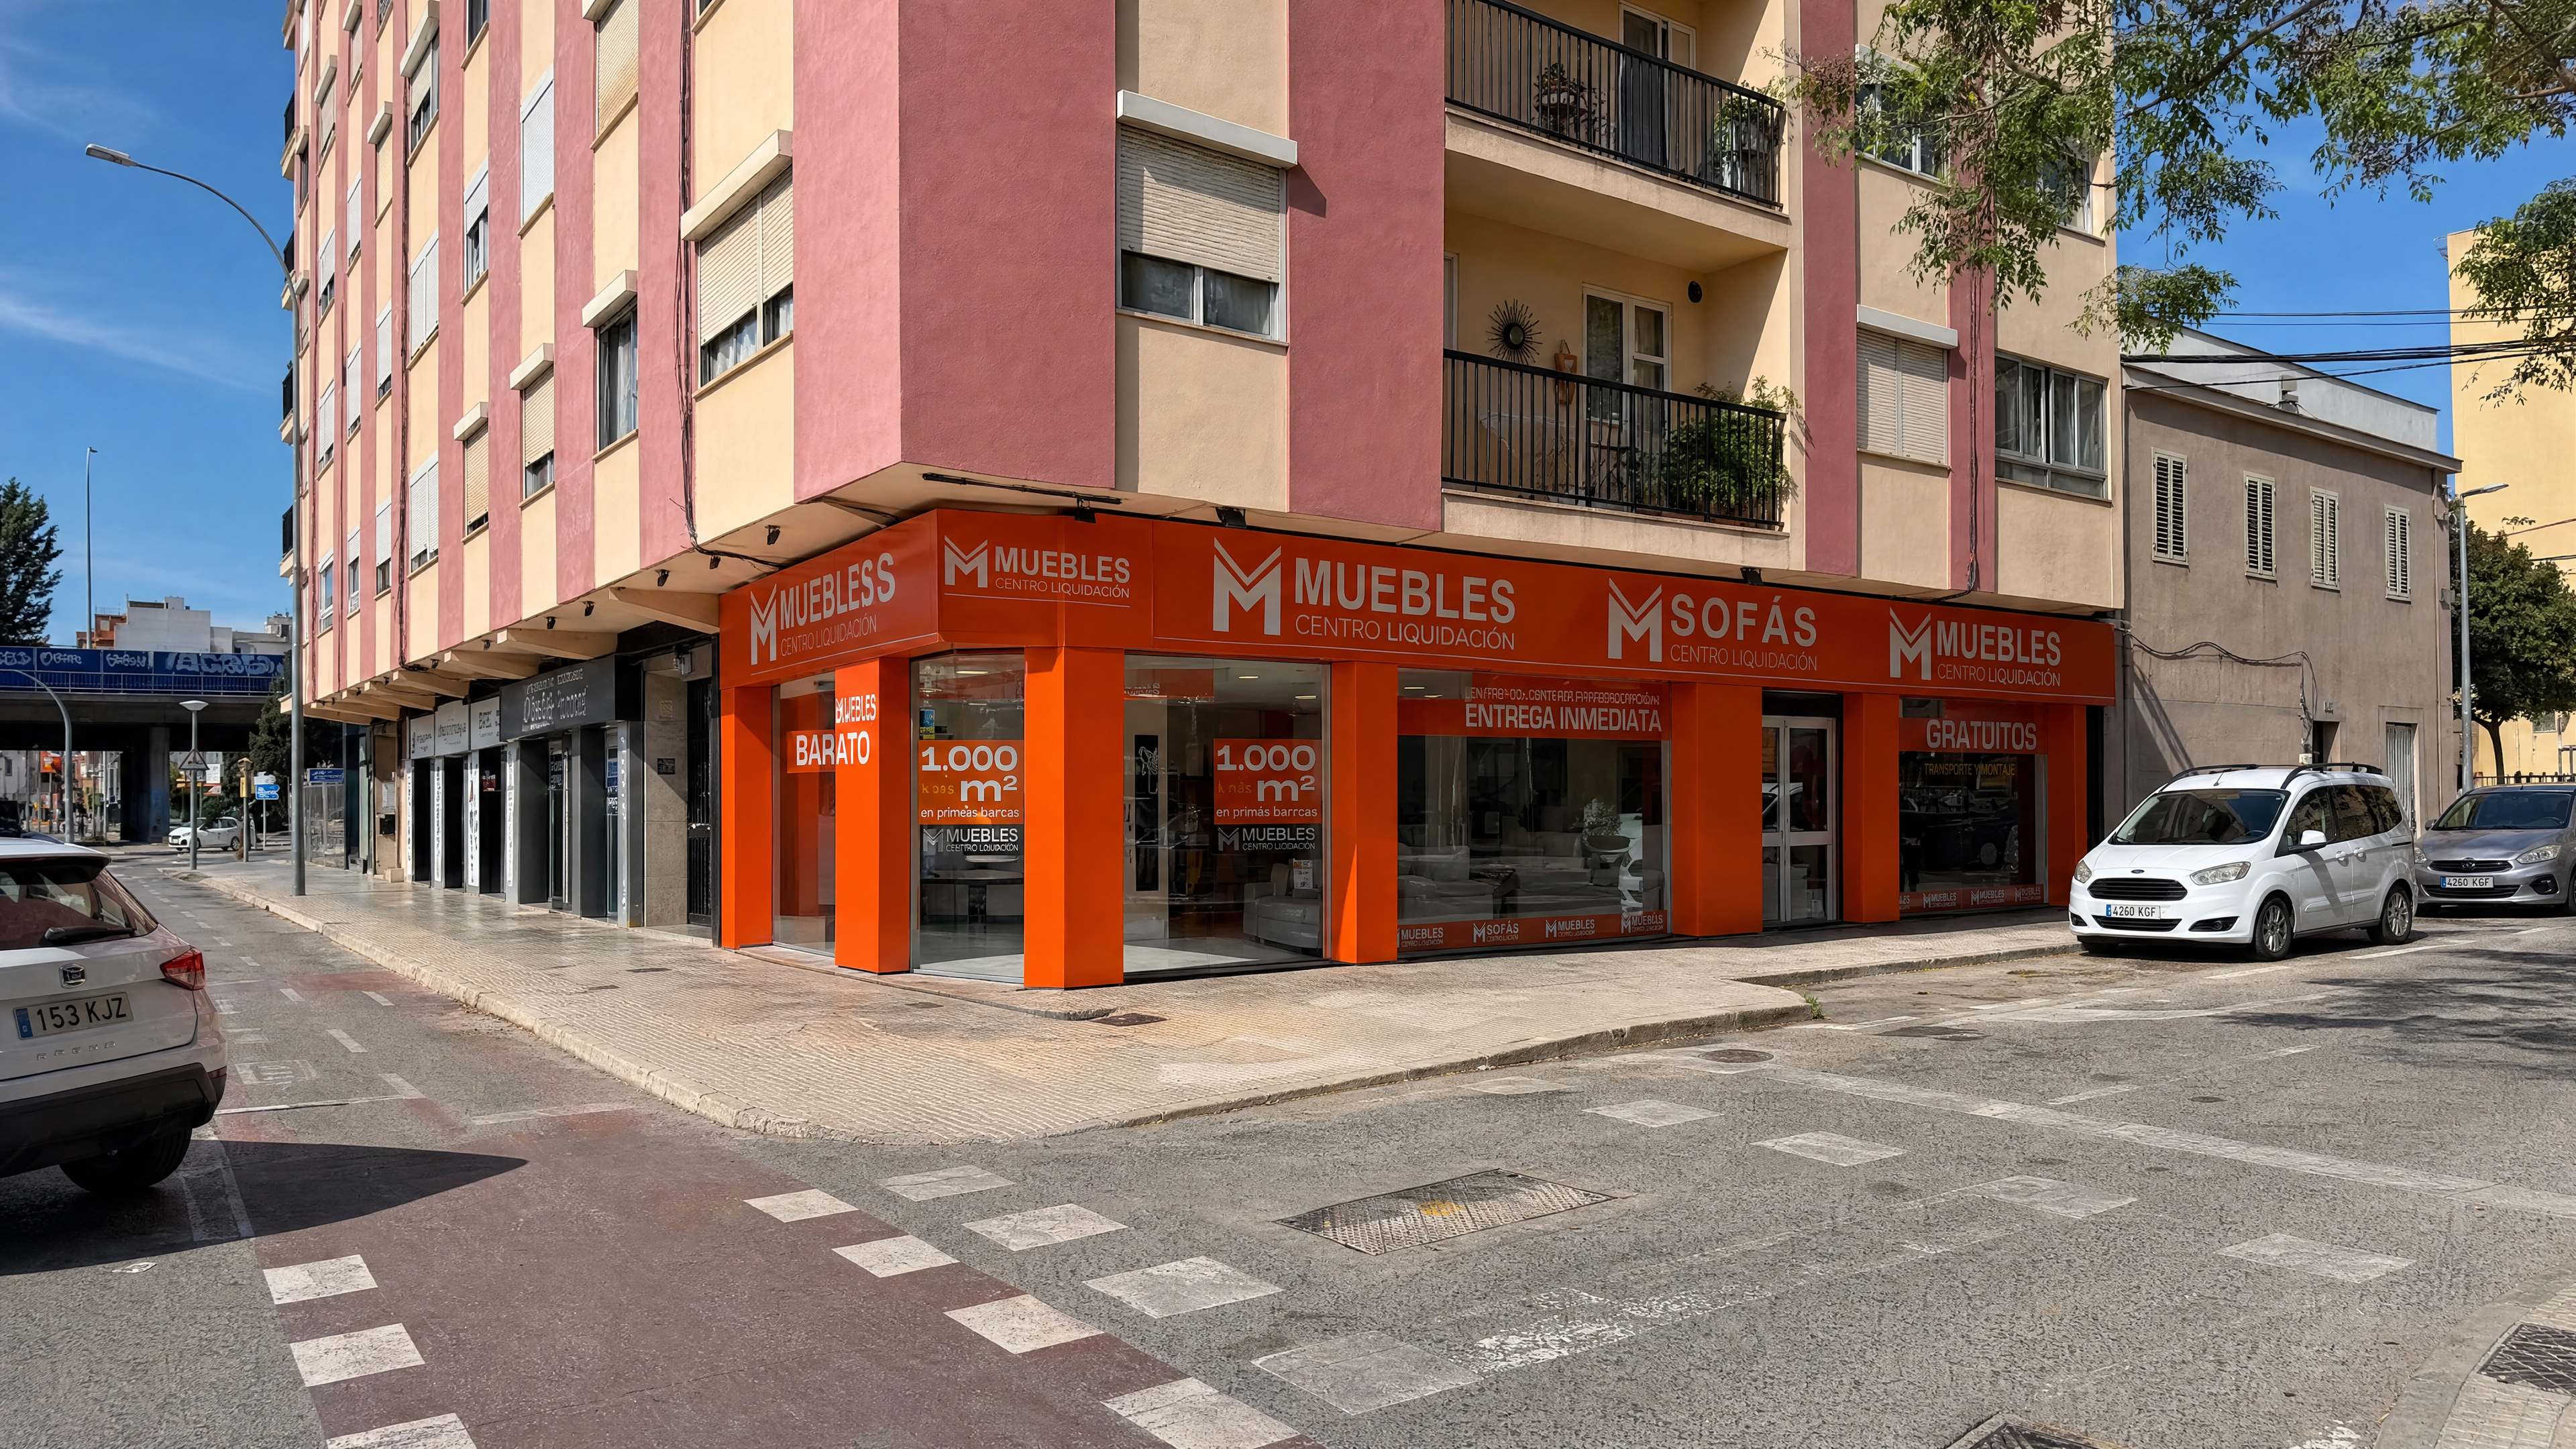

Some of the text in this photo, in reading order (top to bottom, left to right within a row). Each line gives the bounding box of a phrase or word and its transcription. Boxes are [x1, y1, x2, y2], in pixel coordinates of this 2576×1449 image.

[995, 545, 1130, 584] MUEBLES
[780, 552, 896, 630] MUEBLESS
[995, 578, 1130, 598] CENTRO LIQUIDACIÓN
[1295, 557, 1515, 624] MUEBLES
[1295, 614, 1515, 651] CENTRO LIQUIDACIÓN
[1670, 594, 1817, 647] SOFÁS
[781, 633, 814, 657] CENTRO
[1937, 621, 2061, 666] MUEBLES
[1670, 644, 1817, 671] CENTRO LIQUIDACIÓN
[1937, 663, 2061, 687] CENTRO LIQUIDACIÓN
[1466, 704, 1662, 732] ENTREGA INMEDIATA
[1926, 719, 2037, 751] GRATUITOS
[796, 731, 870, 766] BARATO
[922, 745, 1018, 771] 1.000
[1217, 745, 1316, 771] 1.000
[1924, 763, 2015, 775] TRANSPORTE Y MONTAJE
[921, 810, 934, 818] en
[981, 806, 1019, 818] barcas
[1216, 806, 1318, 819] en primás barrcas
[947, 828, 1018, 843] MUEBLES
[1242, 828, 1316, 841] MUEBLES
[1242, 843, 1273, 851] CENTRO
[2447, 877, 2490, 887] 4260 KGF
[1931, 892, 1957, 902] MUEBLES
[2112, 906, 2156, 917] 4260 KGF
[1401, 927, 1444, 940] MUEBLES
[1487, 920, 1519, 935] SOFÁS
[1558, 919, 1595, 931] MUEBLES
[37, 998, 127, 1031] 153 KJZ
